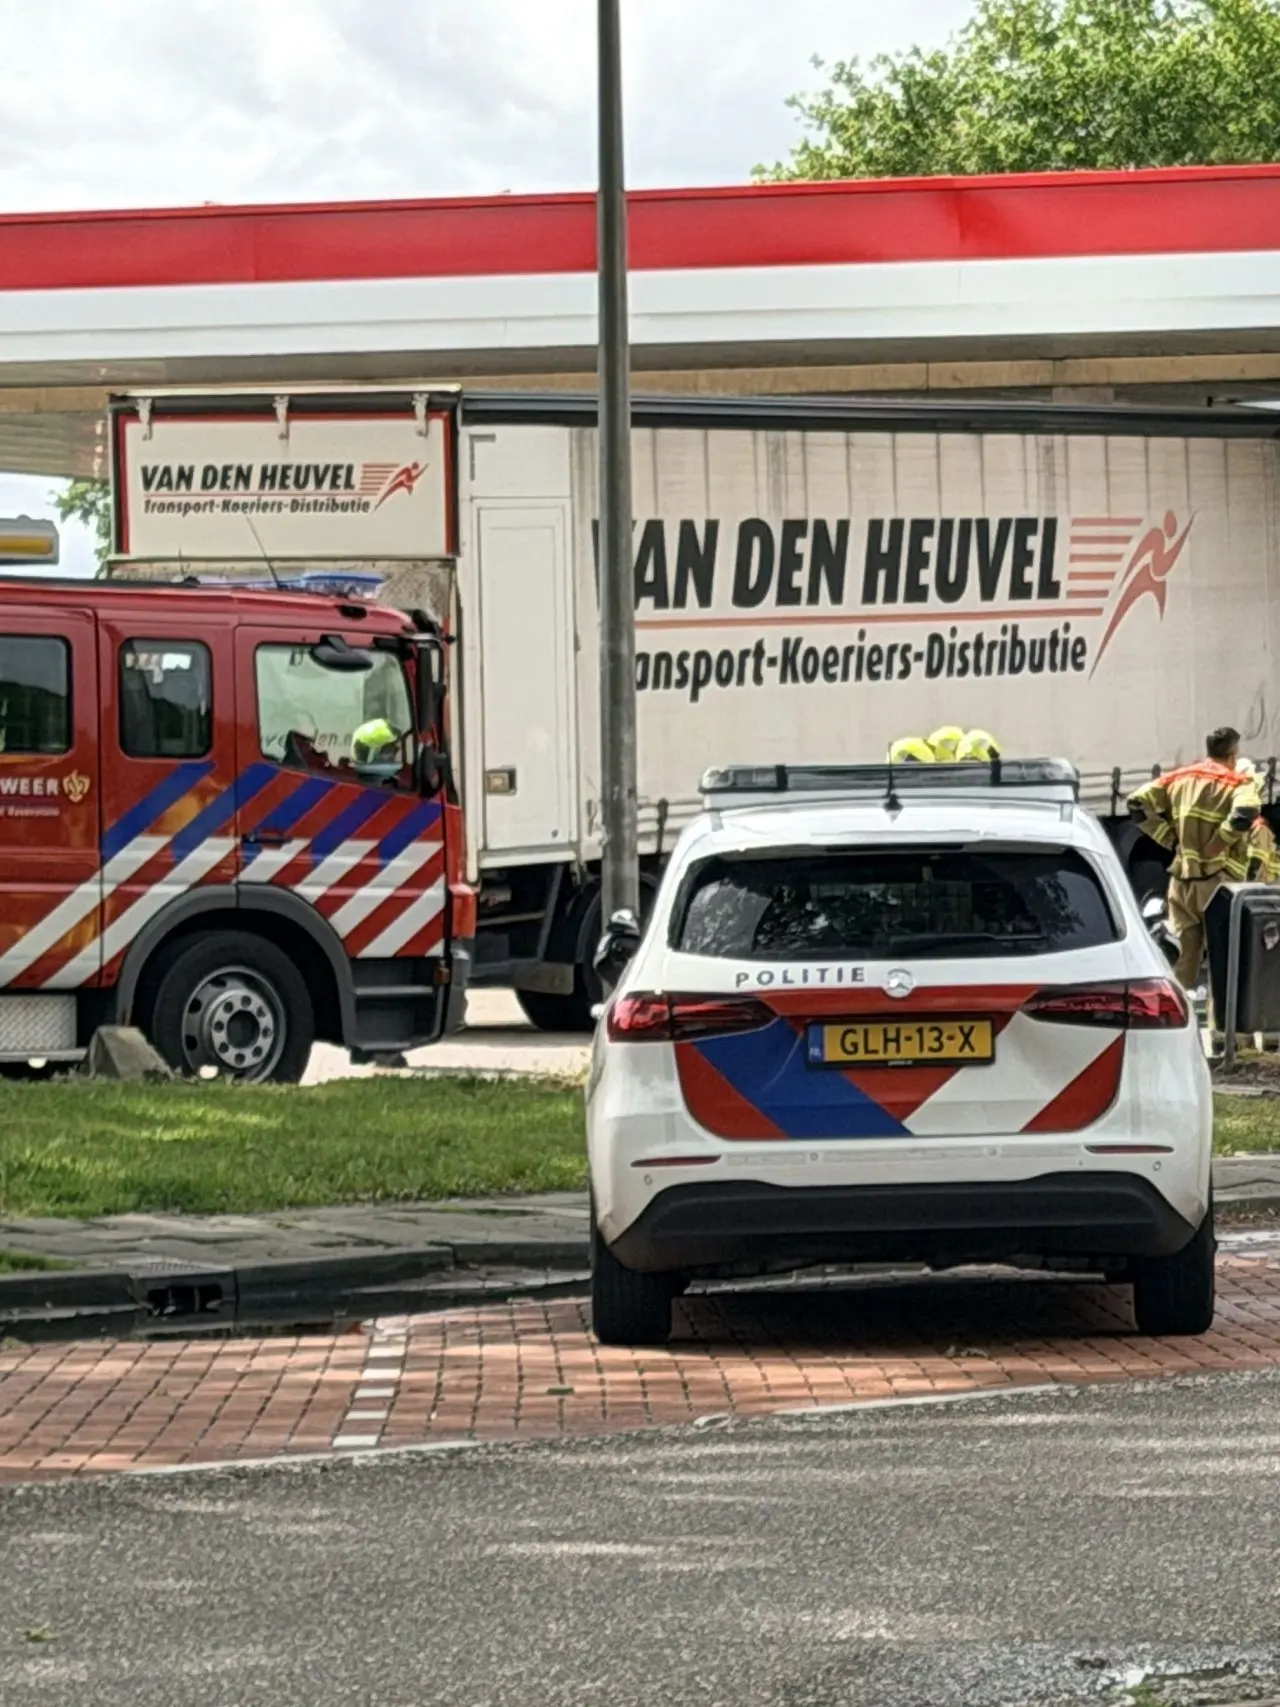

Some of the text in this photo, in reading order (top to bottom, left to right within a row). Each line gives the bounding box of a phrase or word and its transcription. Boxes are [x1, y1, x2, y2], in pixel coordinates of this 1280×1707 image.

[140, 463, 356, 491] VAN DEN HEUVEL
[731, 517, 850, 609] DEN
[861, 517, 1061, 605] HEUVEL
[634, 621, 1087, 703] ansport-Koeriers-Distributie
[735, 966, 866, 988] POLITIE
[840, 1024, 976, 1056] GLH-13-X
